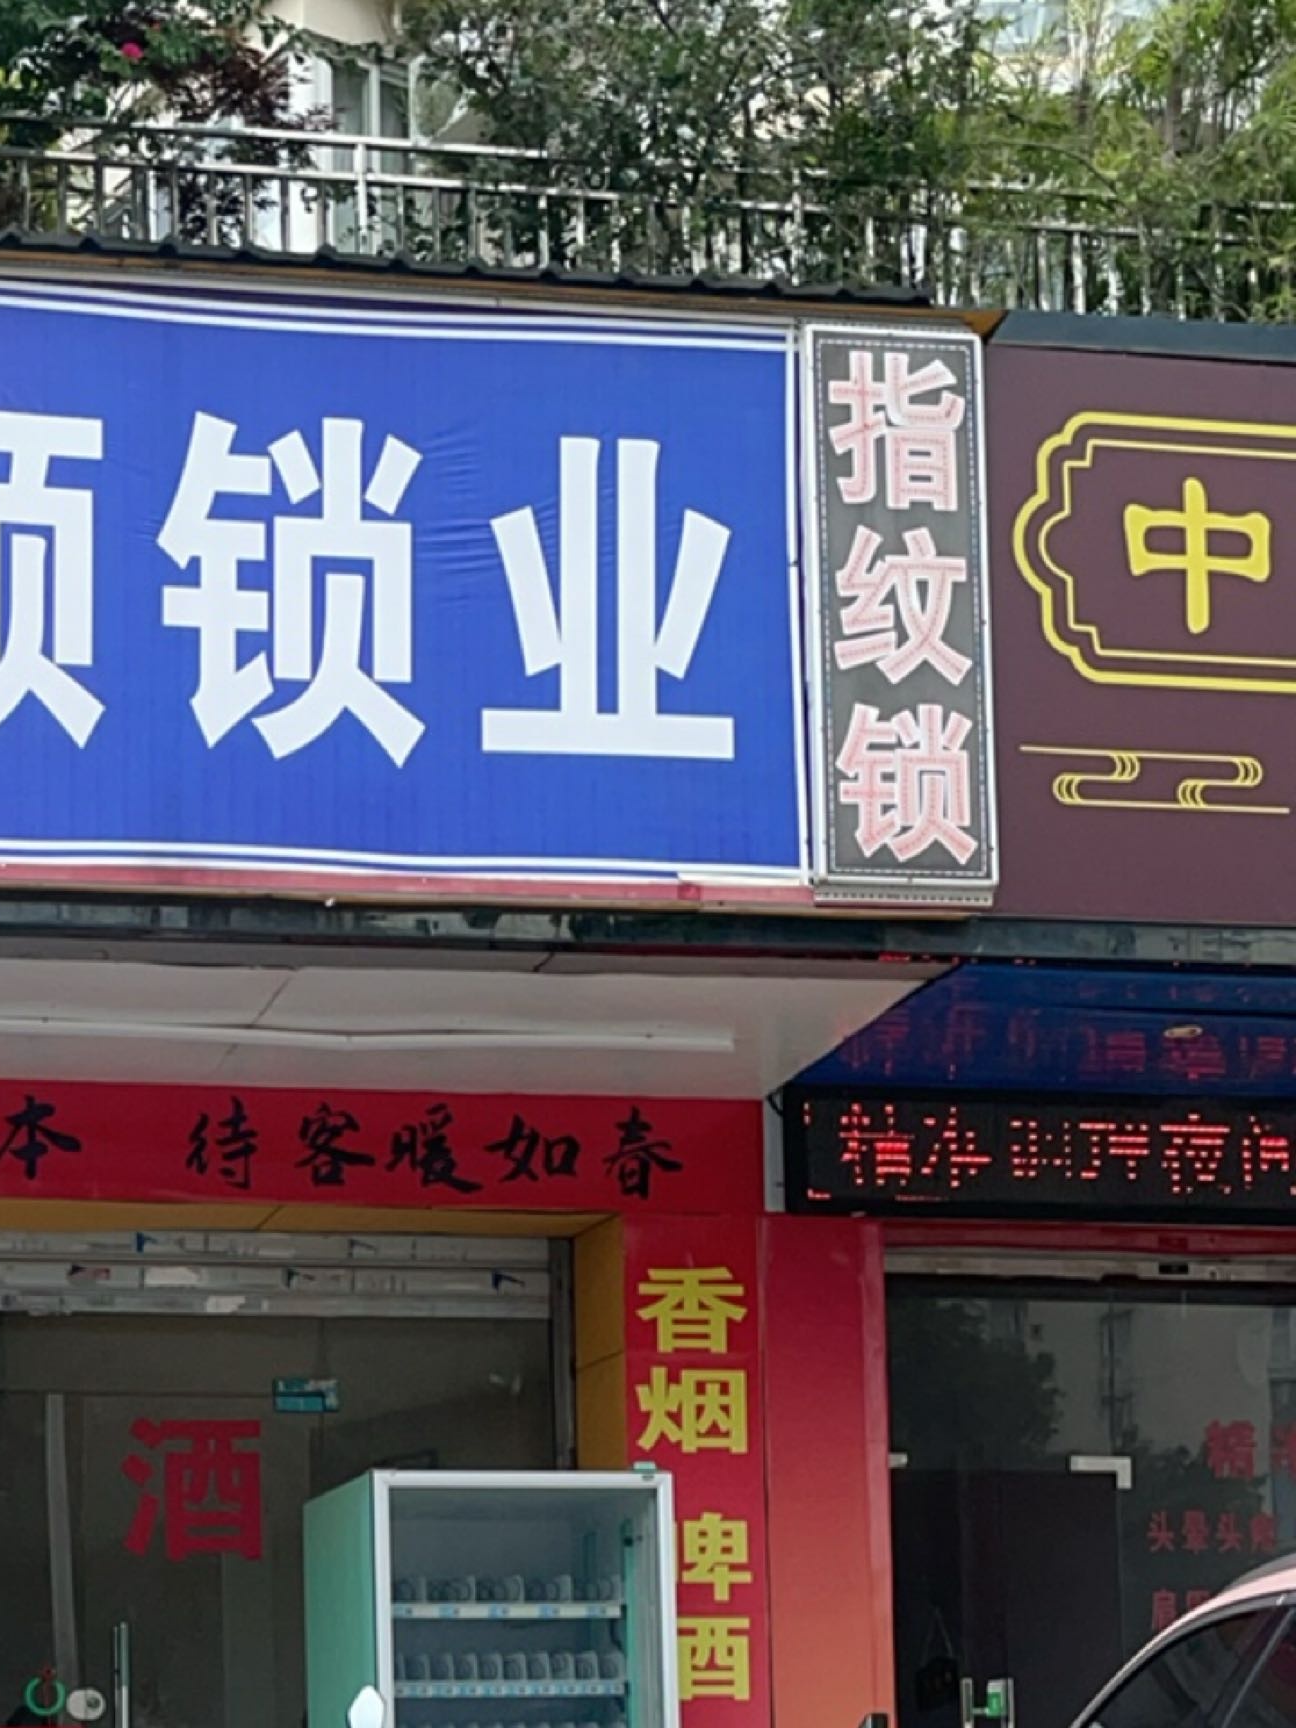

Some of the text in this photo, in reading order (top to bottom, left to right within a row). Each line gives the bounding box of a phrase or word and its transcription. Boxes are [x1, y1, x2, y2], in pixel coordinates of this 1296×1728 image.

[829, 350, 978, 865] 指纹锁
[1123, 477, 1272, 633] 中
[185, 1096, 683, 1199] 待客暖如春
[636, 1265, 748, 1456] 香烟
[121, 1417, 263, 1563] 酒
